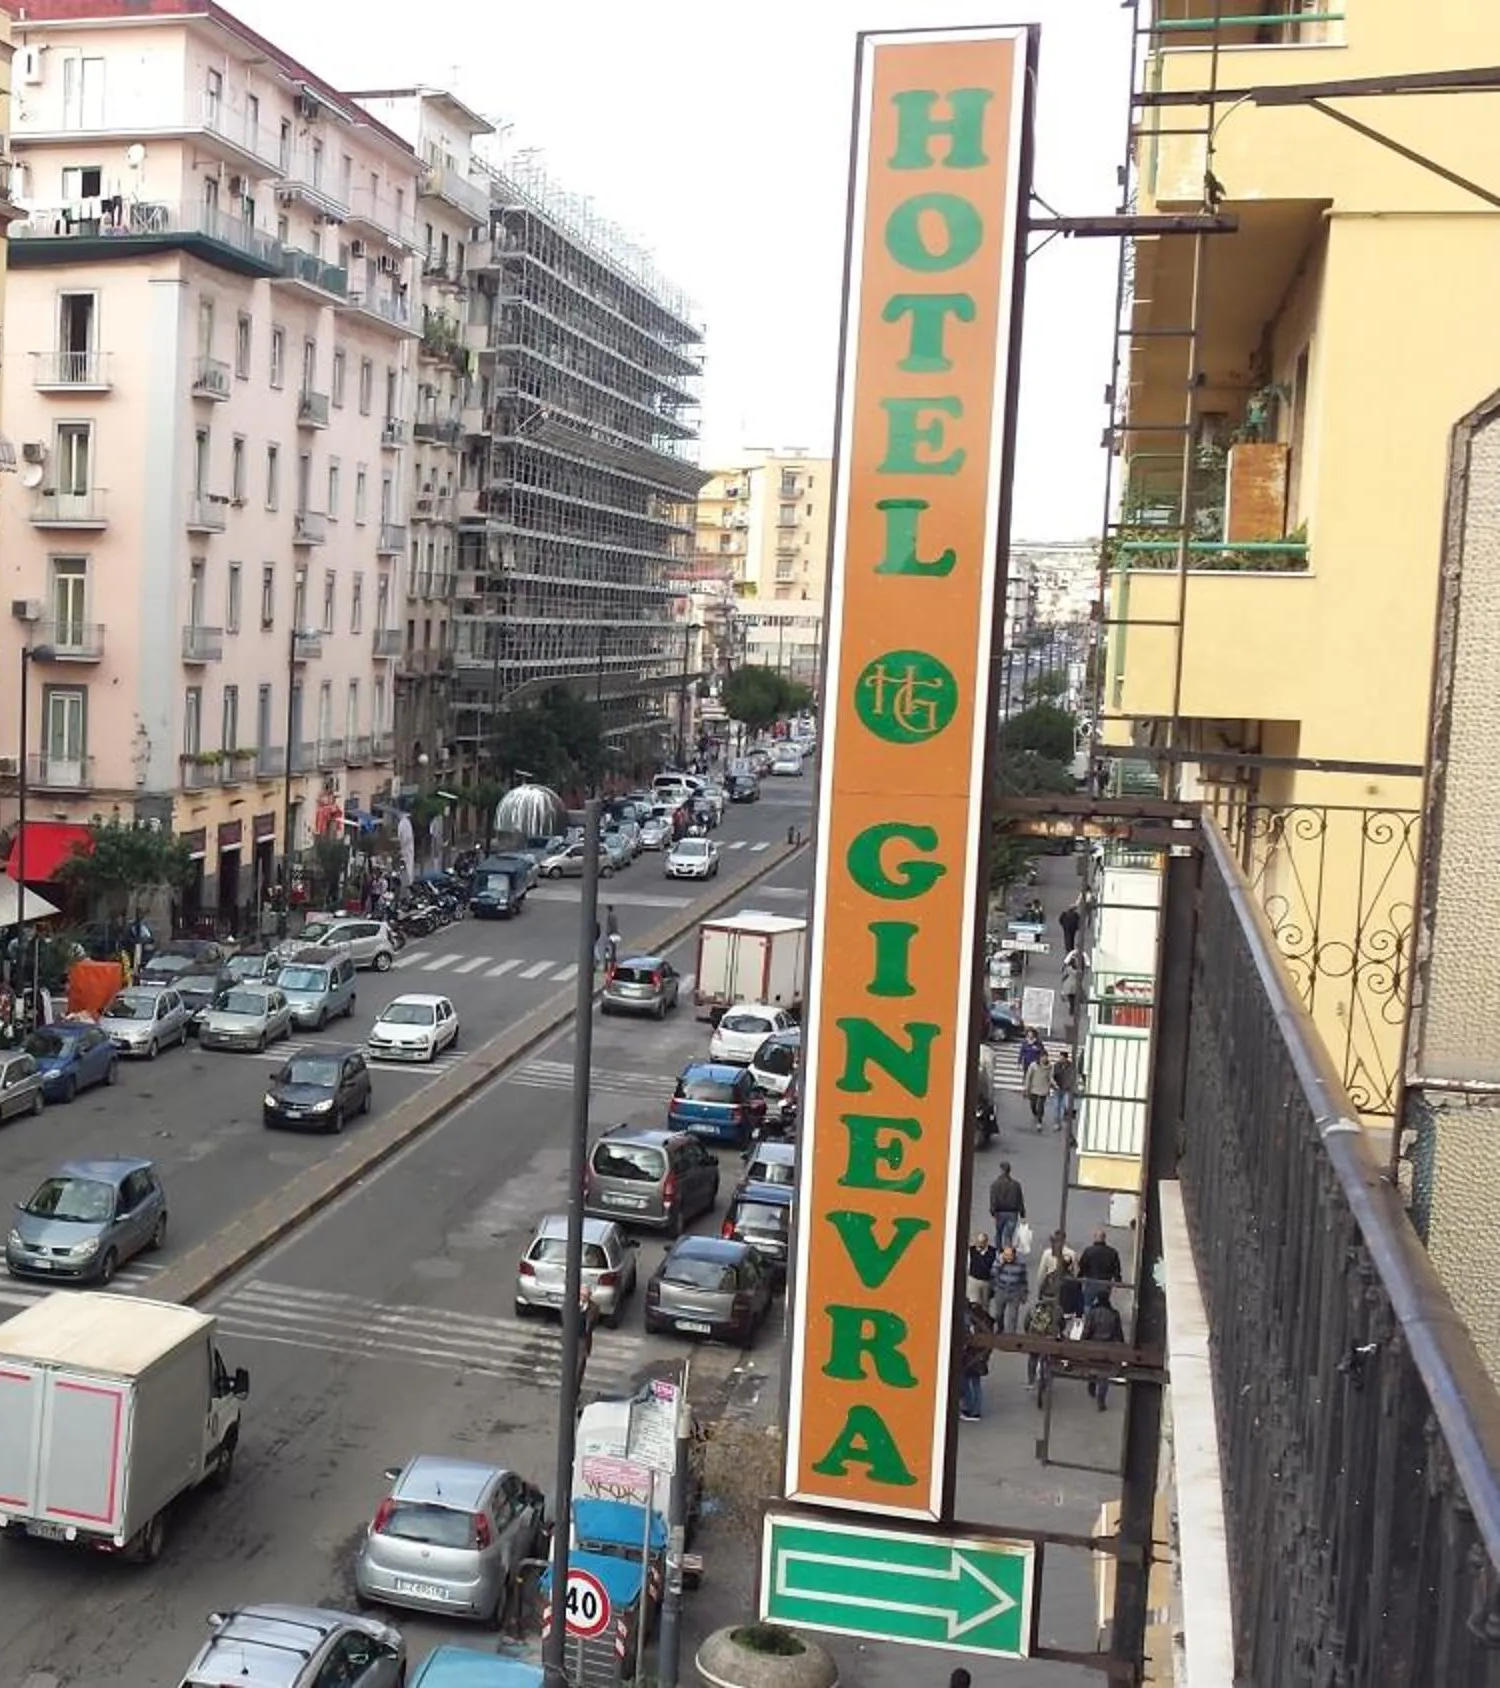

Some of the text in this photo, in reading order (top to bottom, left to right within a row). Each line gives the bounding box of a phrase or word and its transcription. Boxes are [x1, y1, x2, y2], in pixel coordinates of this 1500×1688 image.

[872, 87, 996, 577] HOTEL
[811, 821, 947, 1487] GINEVRA
[565, 1586, 597, 1620] 40
